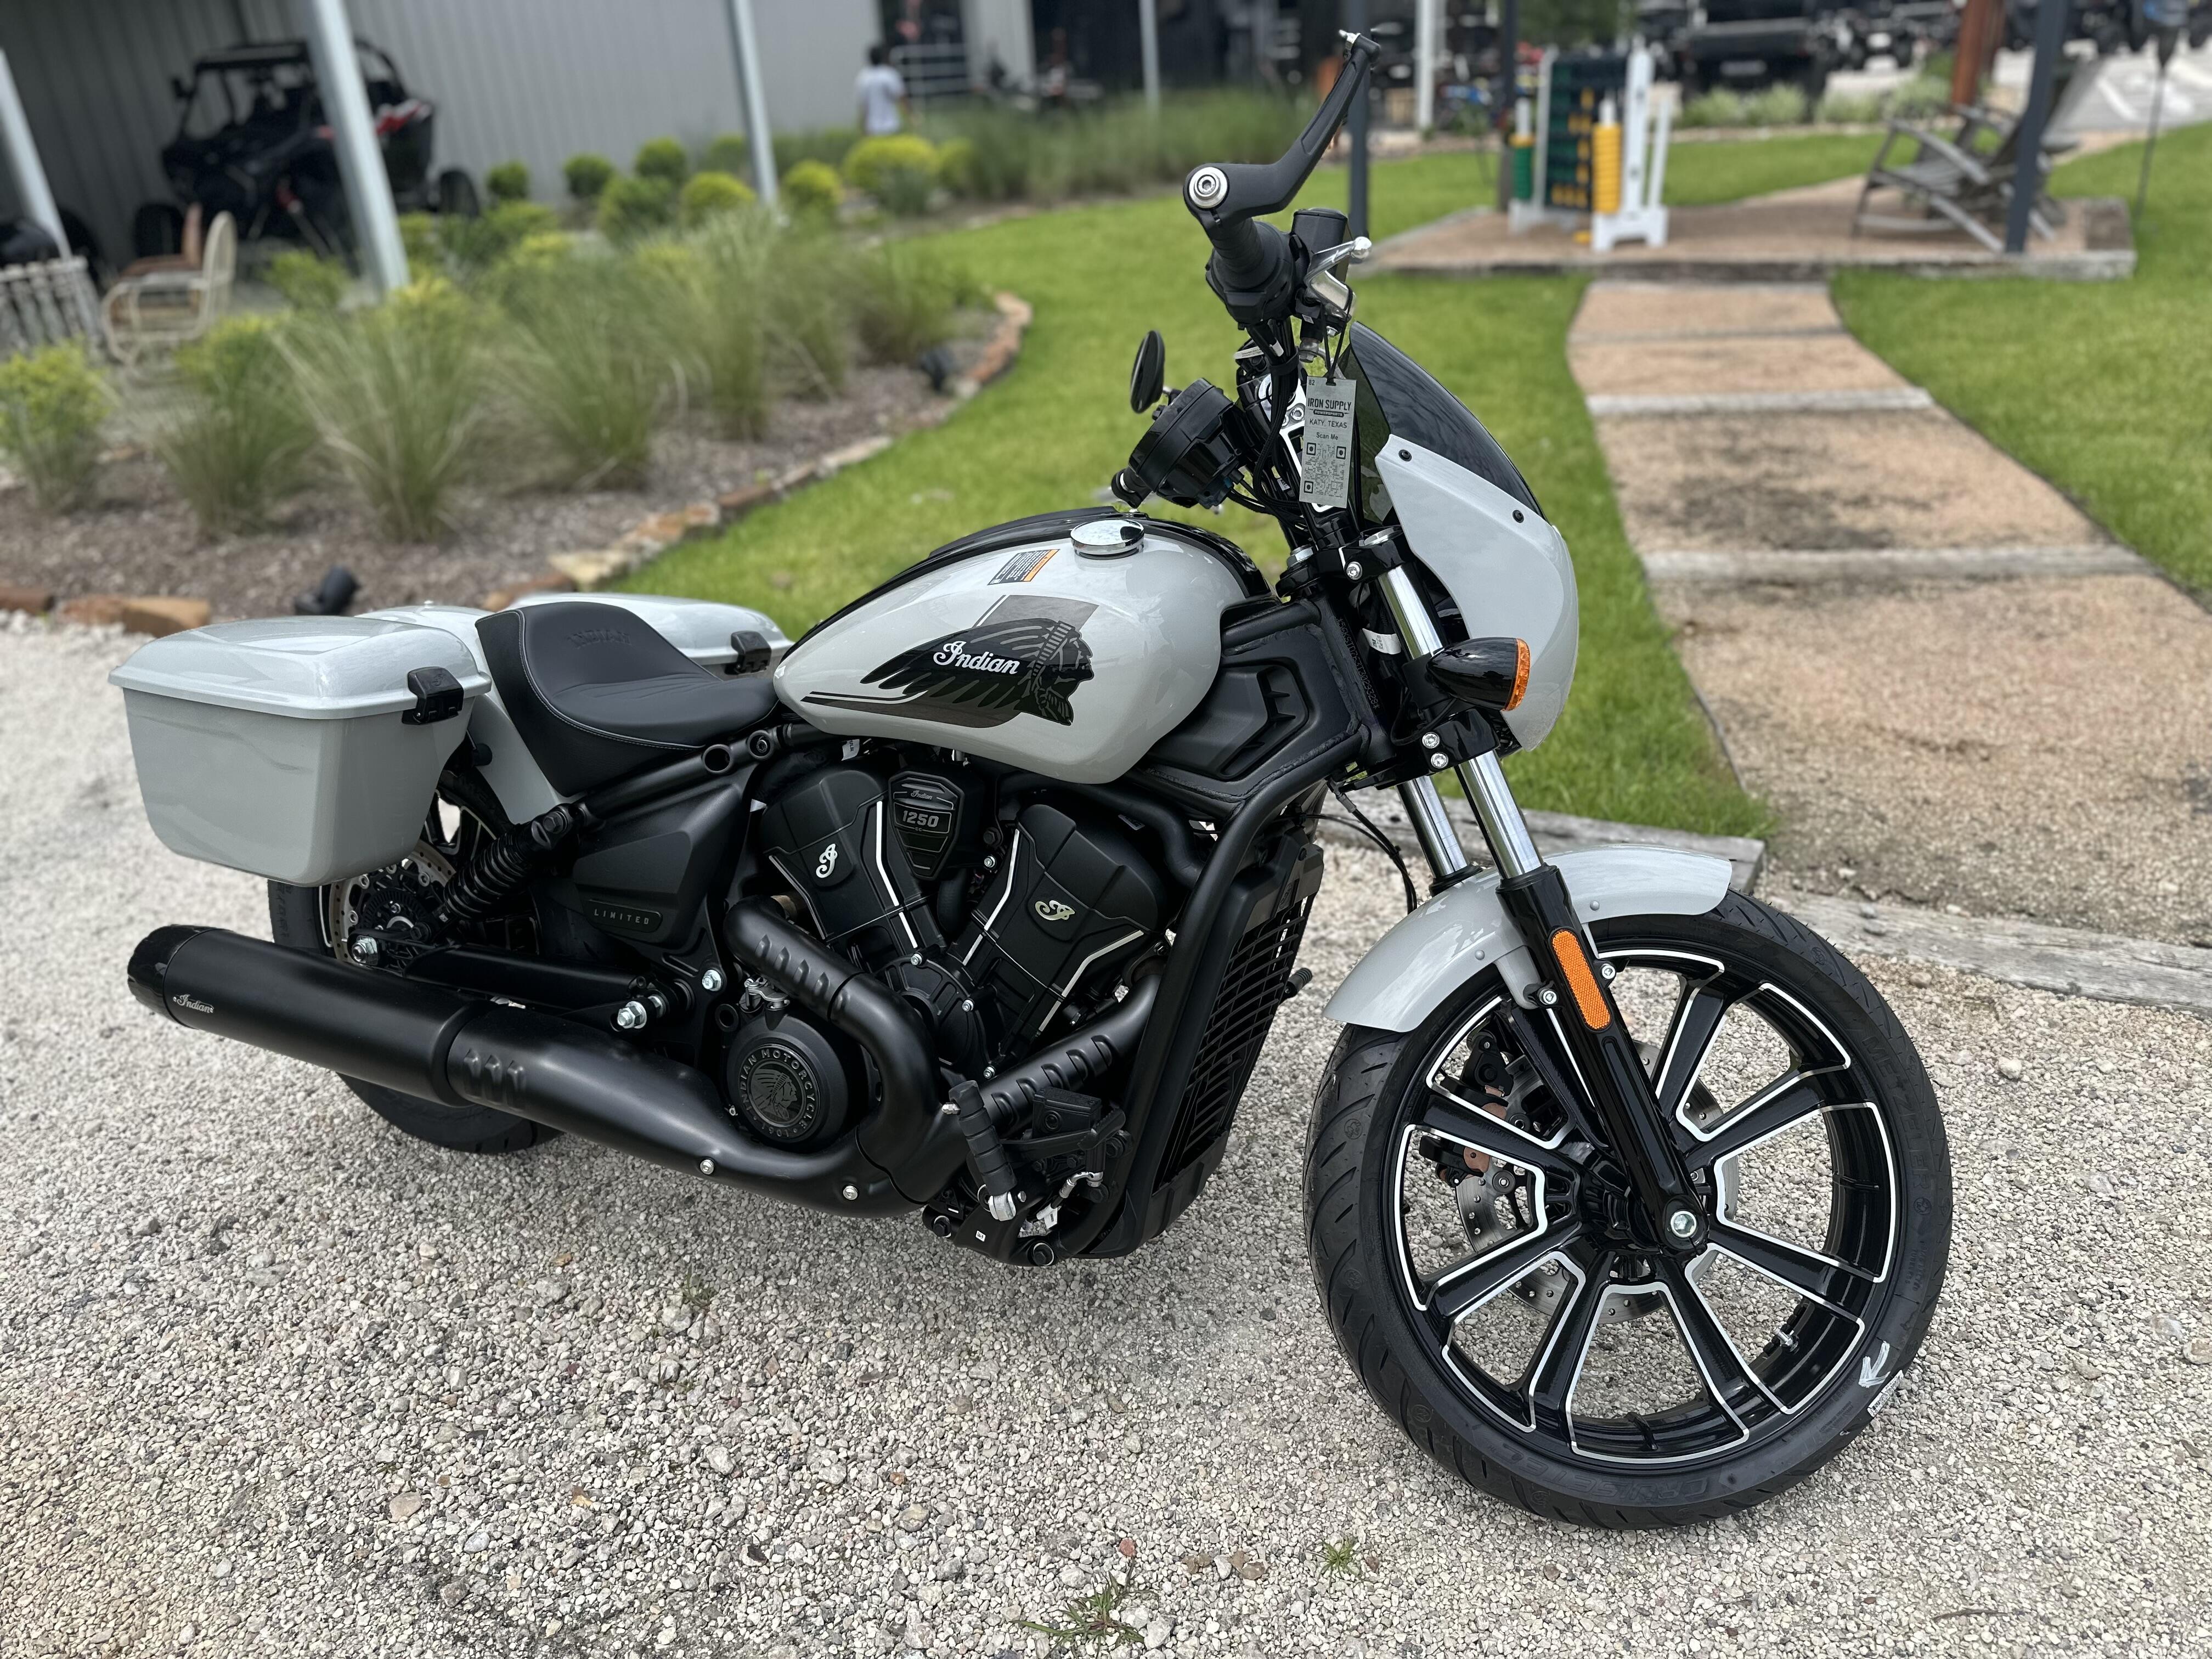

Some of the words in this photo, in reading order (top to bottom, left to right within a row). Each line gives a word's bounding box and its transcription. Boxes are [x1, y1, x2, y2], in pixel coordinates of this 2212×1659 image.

[1307, 398, 1323, 408] IRON
[1325, 399, 1352, 410] SUPPLY
[1328, 420, 1347, 428] TEXAS
[933, 640, 1022, 675] Indian
[911, 790, 933, 800] Indian
[902, 810, 939, 827] 1250
[594, 909, 650, 925] LIMITED
[177, 994, 210, 1013] Indian
[741, 1054, 757, 1110] INDIAN
[761, 1048, 816, 1129] MOTORCYCLE
